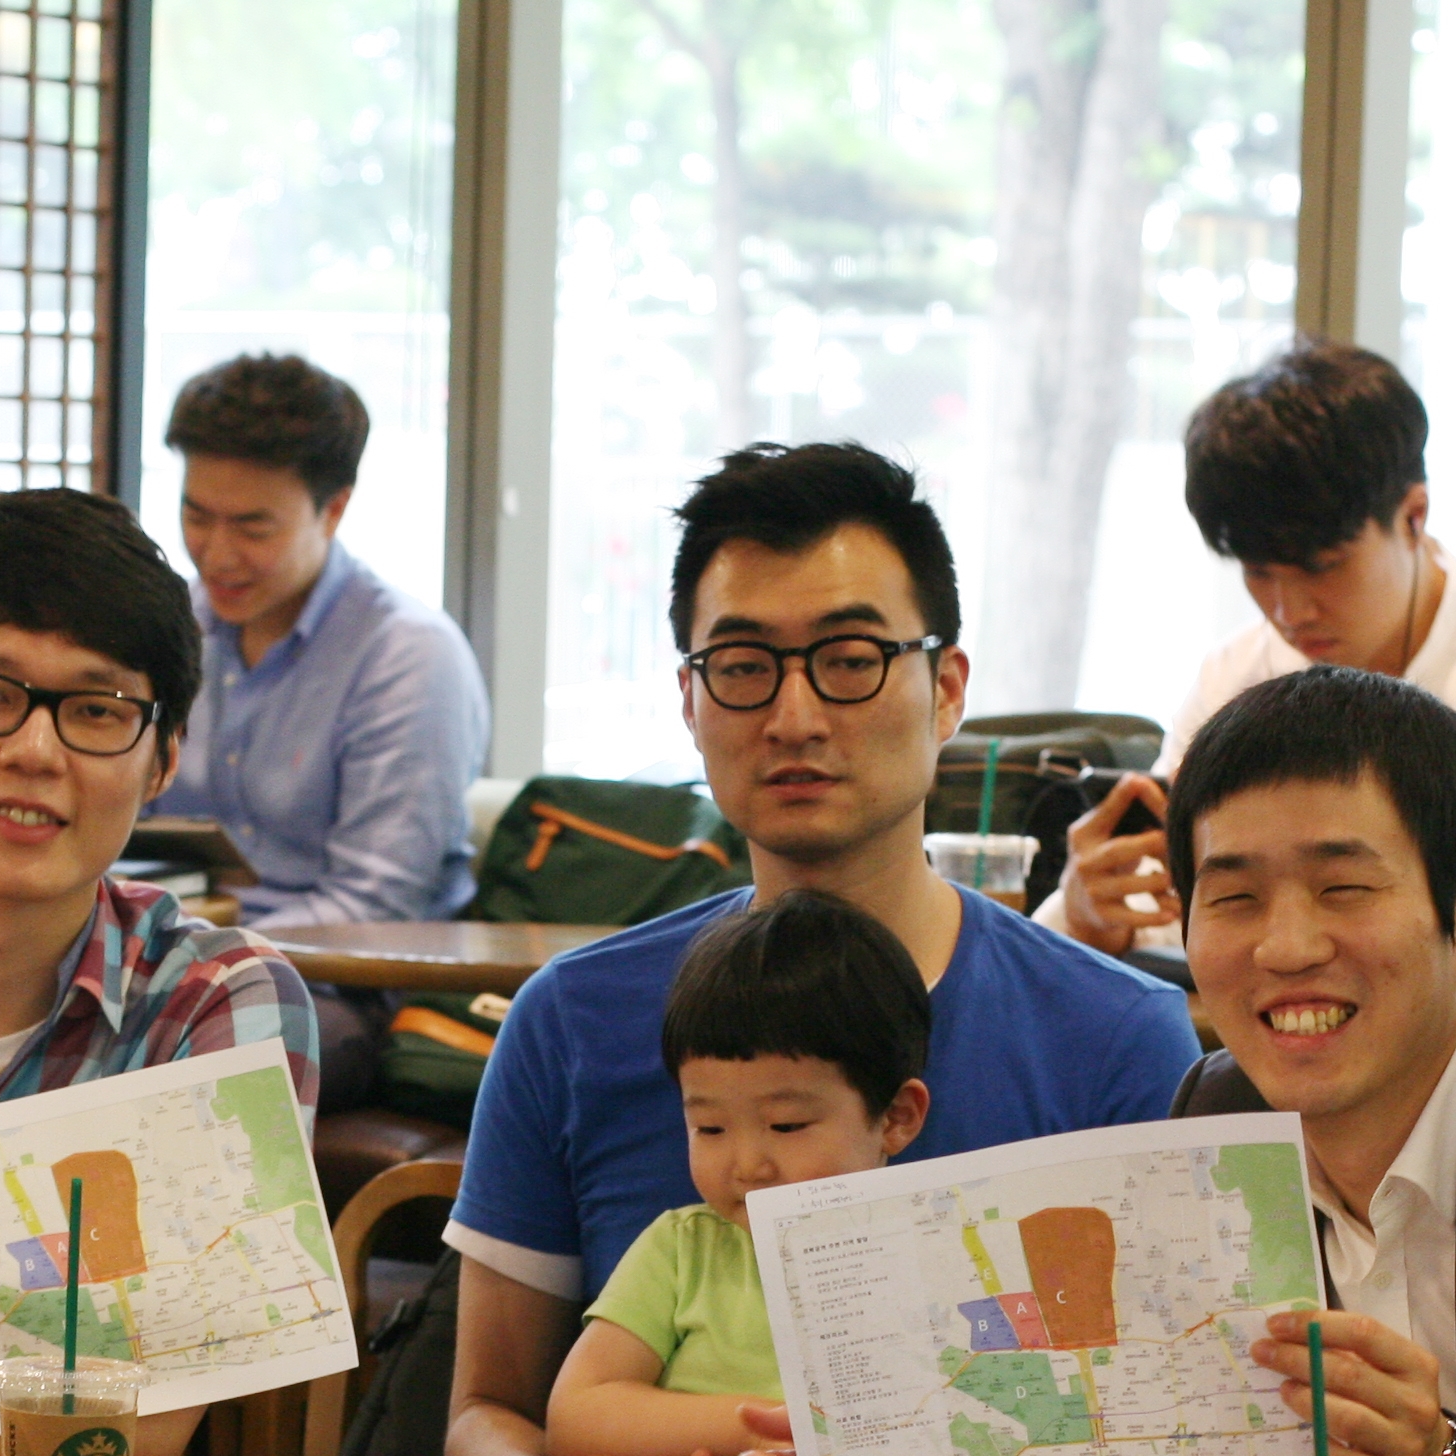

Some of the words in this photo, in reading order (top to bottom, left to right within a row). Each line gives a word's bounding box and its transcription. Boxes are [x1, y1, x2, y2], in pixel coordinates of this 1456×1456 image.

[90, 1228, 100, 1241] C
[58, 1241, 67, 1253] A
[25, 1259, 35, 1271] B
[984, 1268, 992, 1280] E
[1056, 1291, 1067, 1304] C
[1017, 1302, 1028, 1314] A
[978, 1319, 988, 1332] B
[1016, 1386, 1026, 1399] D
